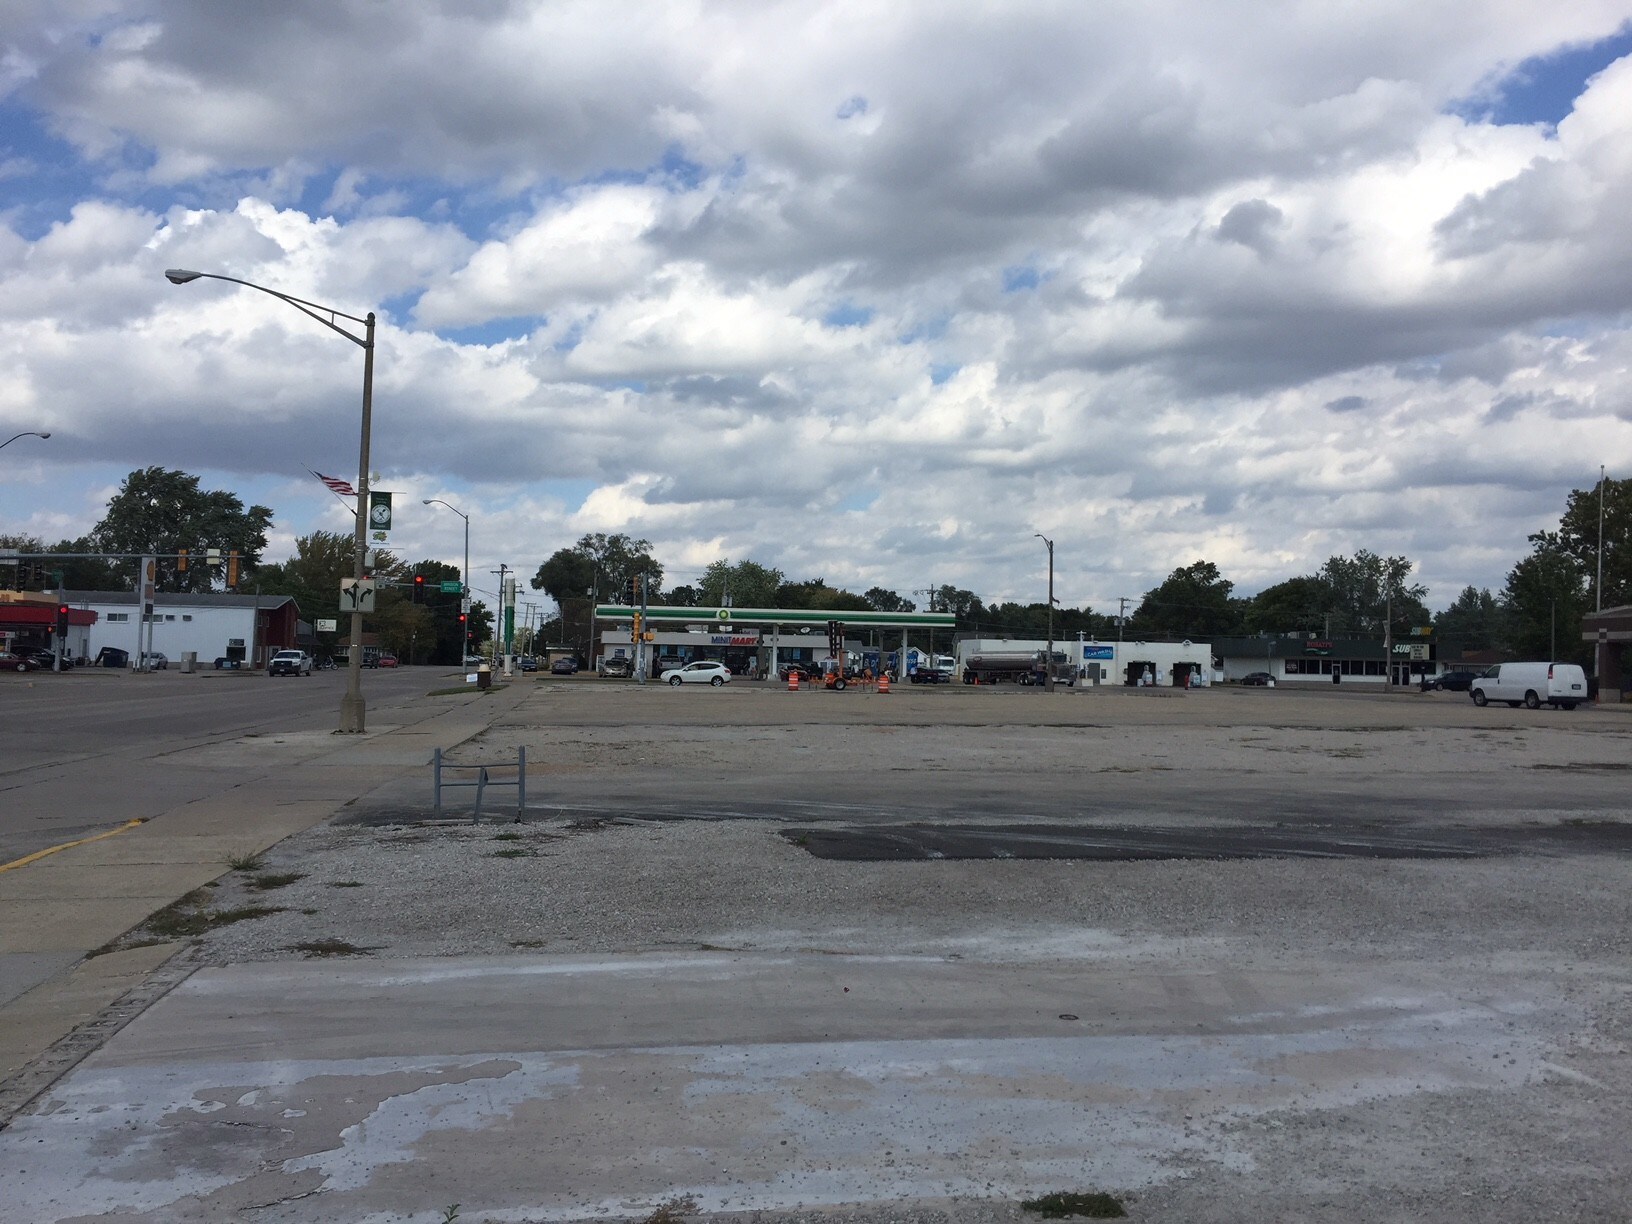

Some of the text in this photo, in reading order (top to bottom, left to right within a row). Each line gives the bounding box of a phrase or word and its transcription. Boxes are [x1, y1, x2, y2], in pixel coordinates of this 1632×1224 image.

[1410, 626, 1434, 636] SUBWAY
[731, 636, 756, 645] MART
[1392, 644, 1411, 653] SUB
